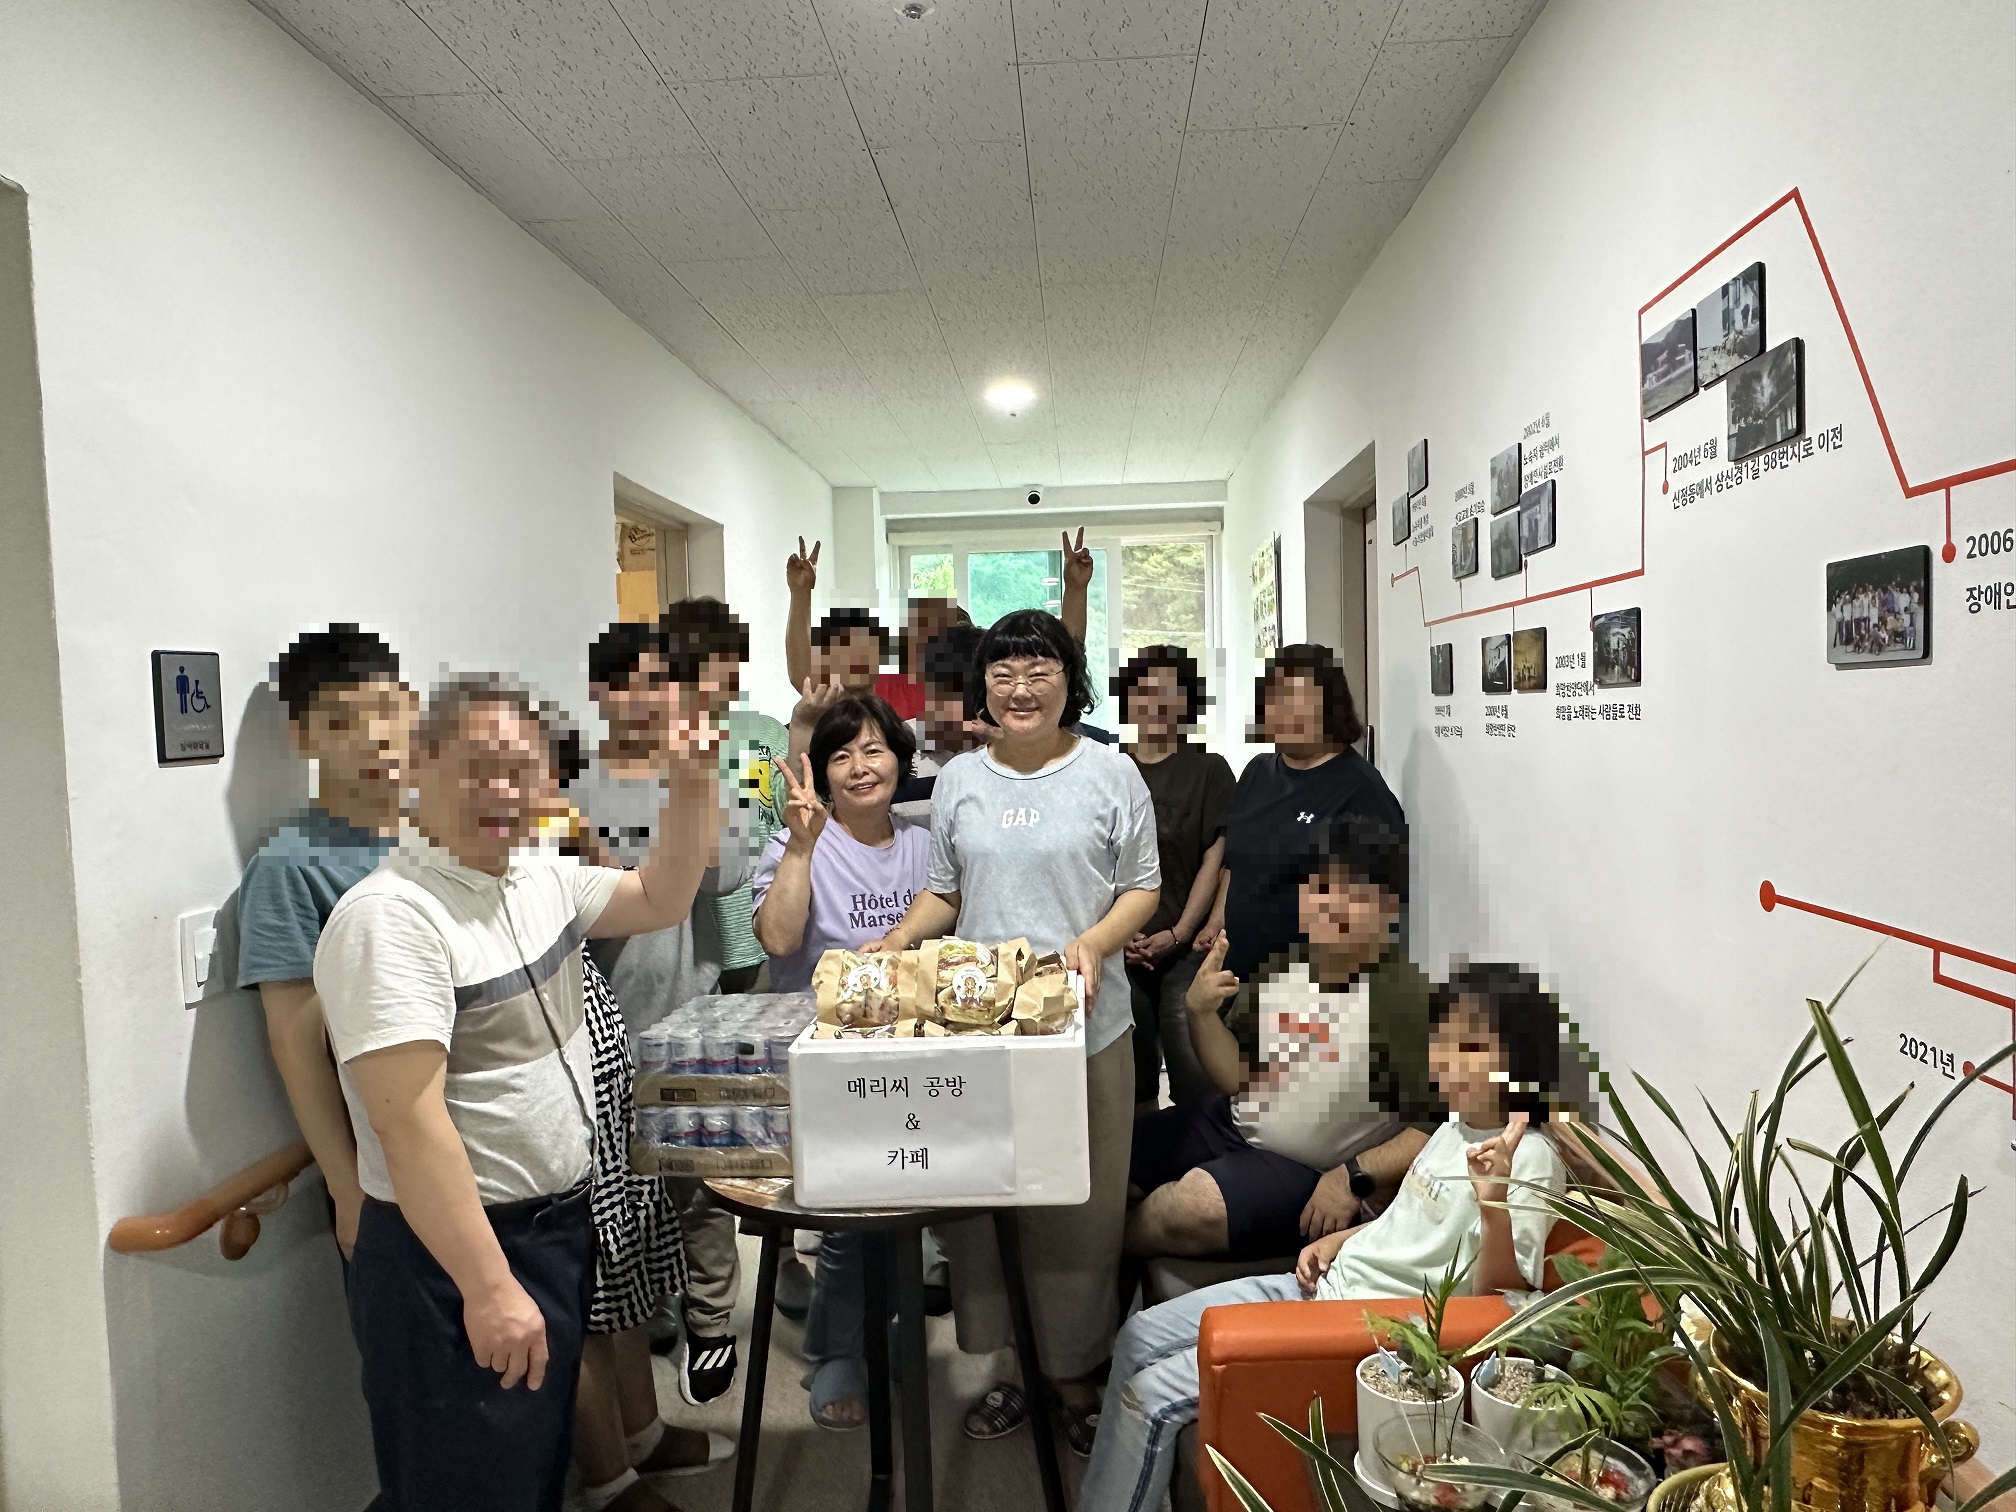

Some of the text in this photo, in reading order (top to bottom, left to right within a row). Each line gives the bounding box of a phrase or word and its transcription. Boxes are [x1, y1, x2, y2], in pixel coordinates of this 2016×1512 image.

[1672, 436, 1718, 474] 2004년 6월
[1672, 475, 1713, 510] 신정동에서
[1763, 436, 1815, 473] 98번지로
[1817, 423, 1844, 453] 이전
[1965, 528, 2014, 560] 2006
[1555, 651, 1587, 669] 2003년 1월
[1573, 704, 1597, 721] 노래하는
[1598, 703, 1626, 721] 사람들로
[1626, 703, 1642, 721] 전환
[1001, 807, 1040, 829] GAP
[850, 890, 900, 912] Hôtel
[847, 907, 909, 930] Marse
[1899, 1032, 1956, 1081] 2021년
[847, 1075, 967, 1099] 메리씨 공방
[905, 1112, 921, 1131] &
[887, 1147, 929, 1170] 카페
